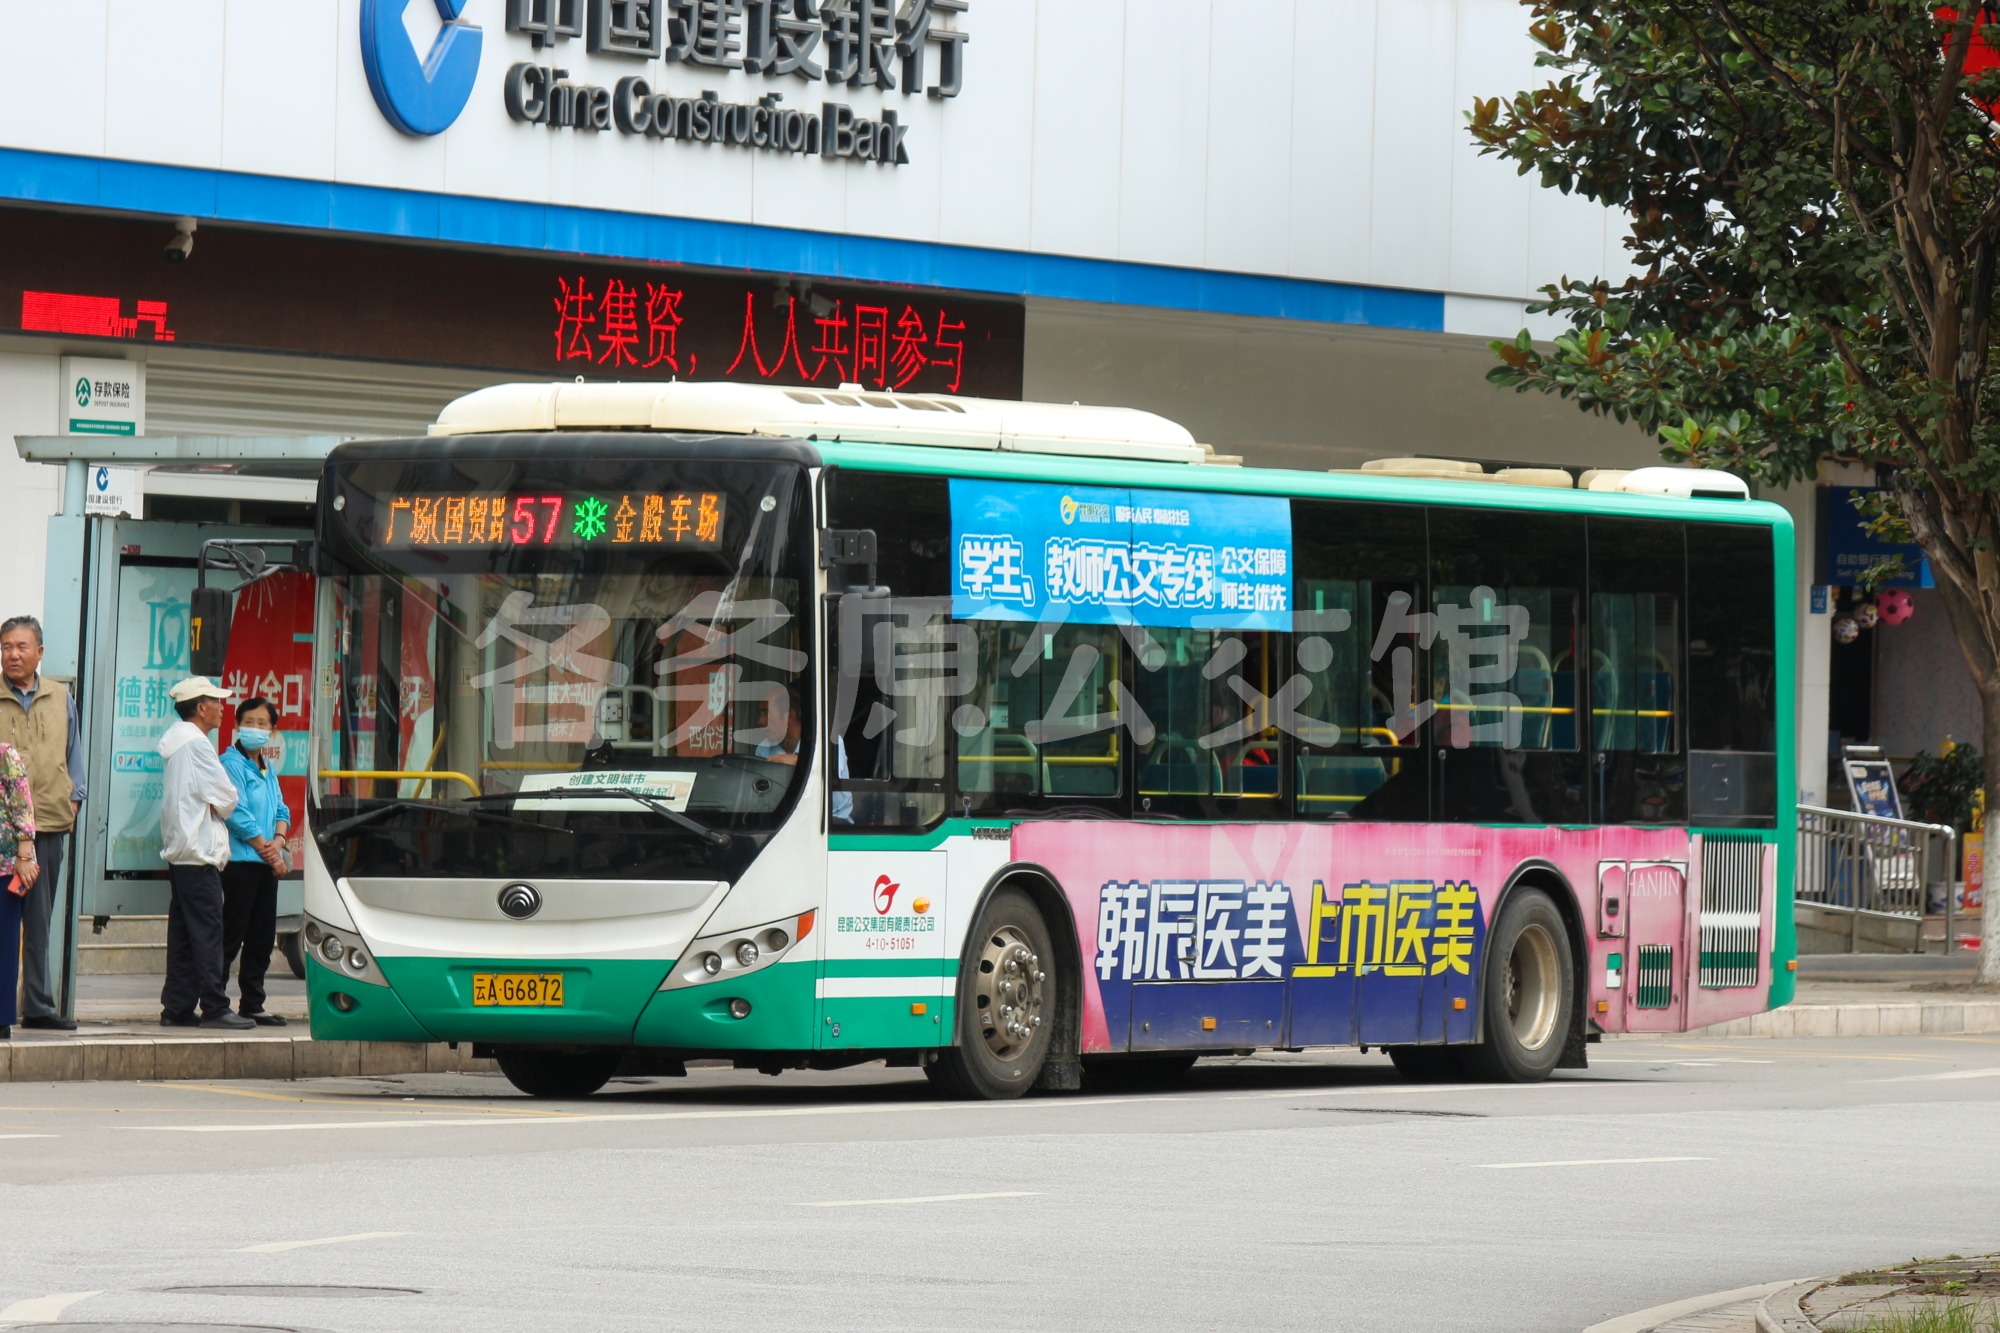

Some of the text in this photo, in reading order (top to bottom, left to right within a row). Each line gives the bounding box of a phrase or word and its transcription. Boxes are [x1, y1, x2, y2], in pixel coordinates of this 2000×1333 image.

[504, 62, 909, 164] China Construction Bank
[94, 381, 130, 398] 存款保险
[87, 494, 122, 506] 国建设银行
[511, 497, 562, 544] 57
[1115, 506, 1152, 525] 服务人民
[1221, 547, 1287, 577] 公交保障
[1221, 582, 1287, 612] 师生优先
[569, 772, 647, 786] 创建文明城市
[838, 916, 935, 932] 昆明公交集团有限责任公司
[1292, 879, 1478, 978] 上市医美
